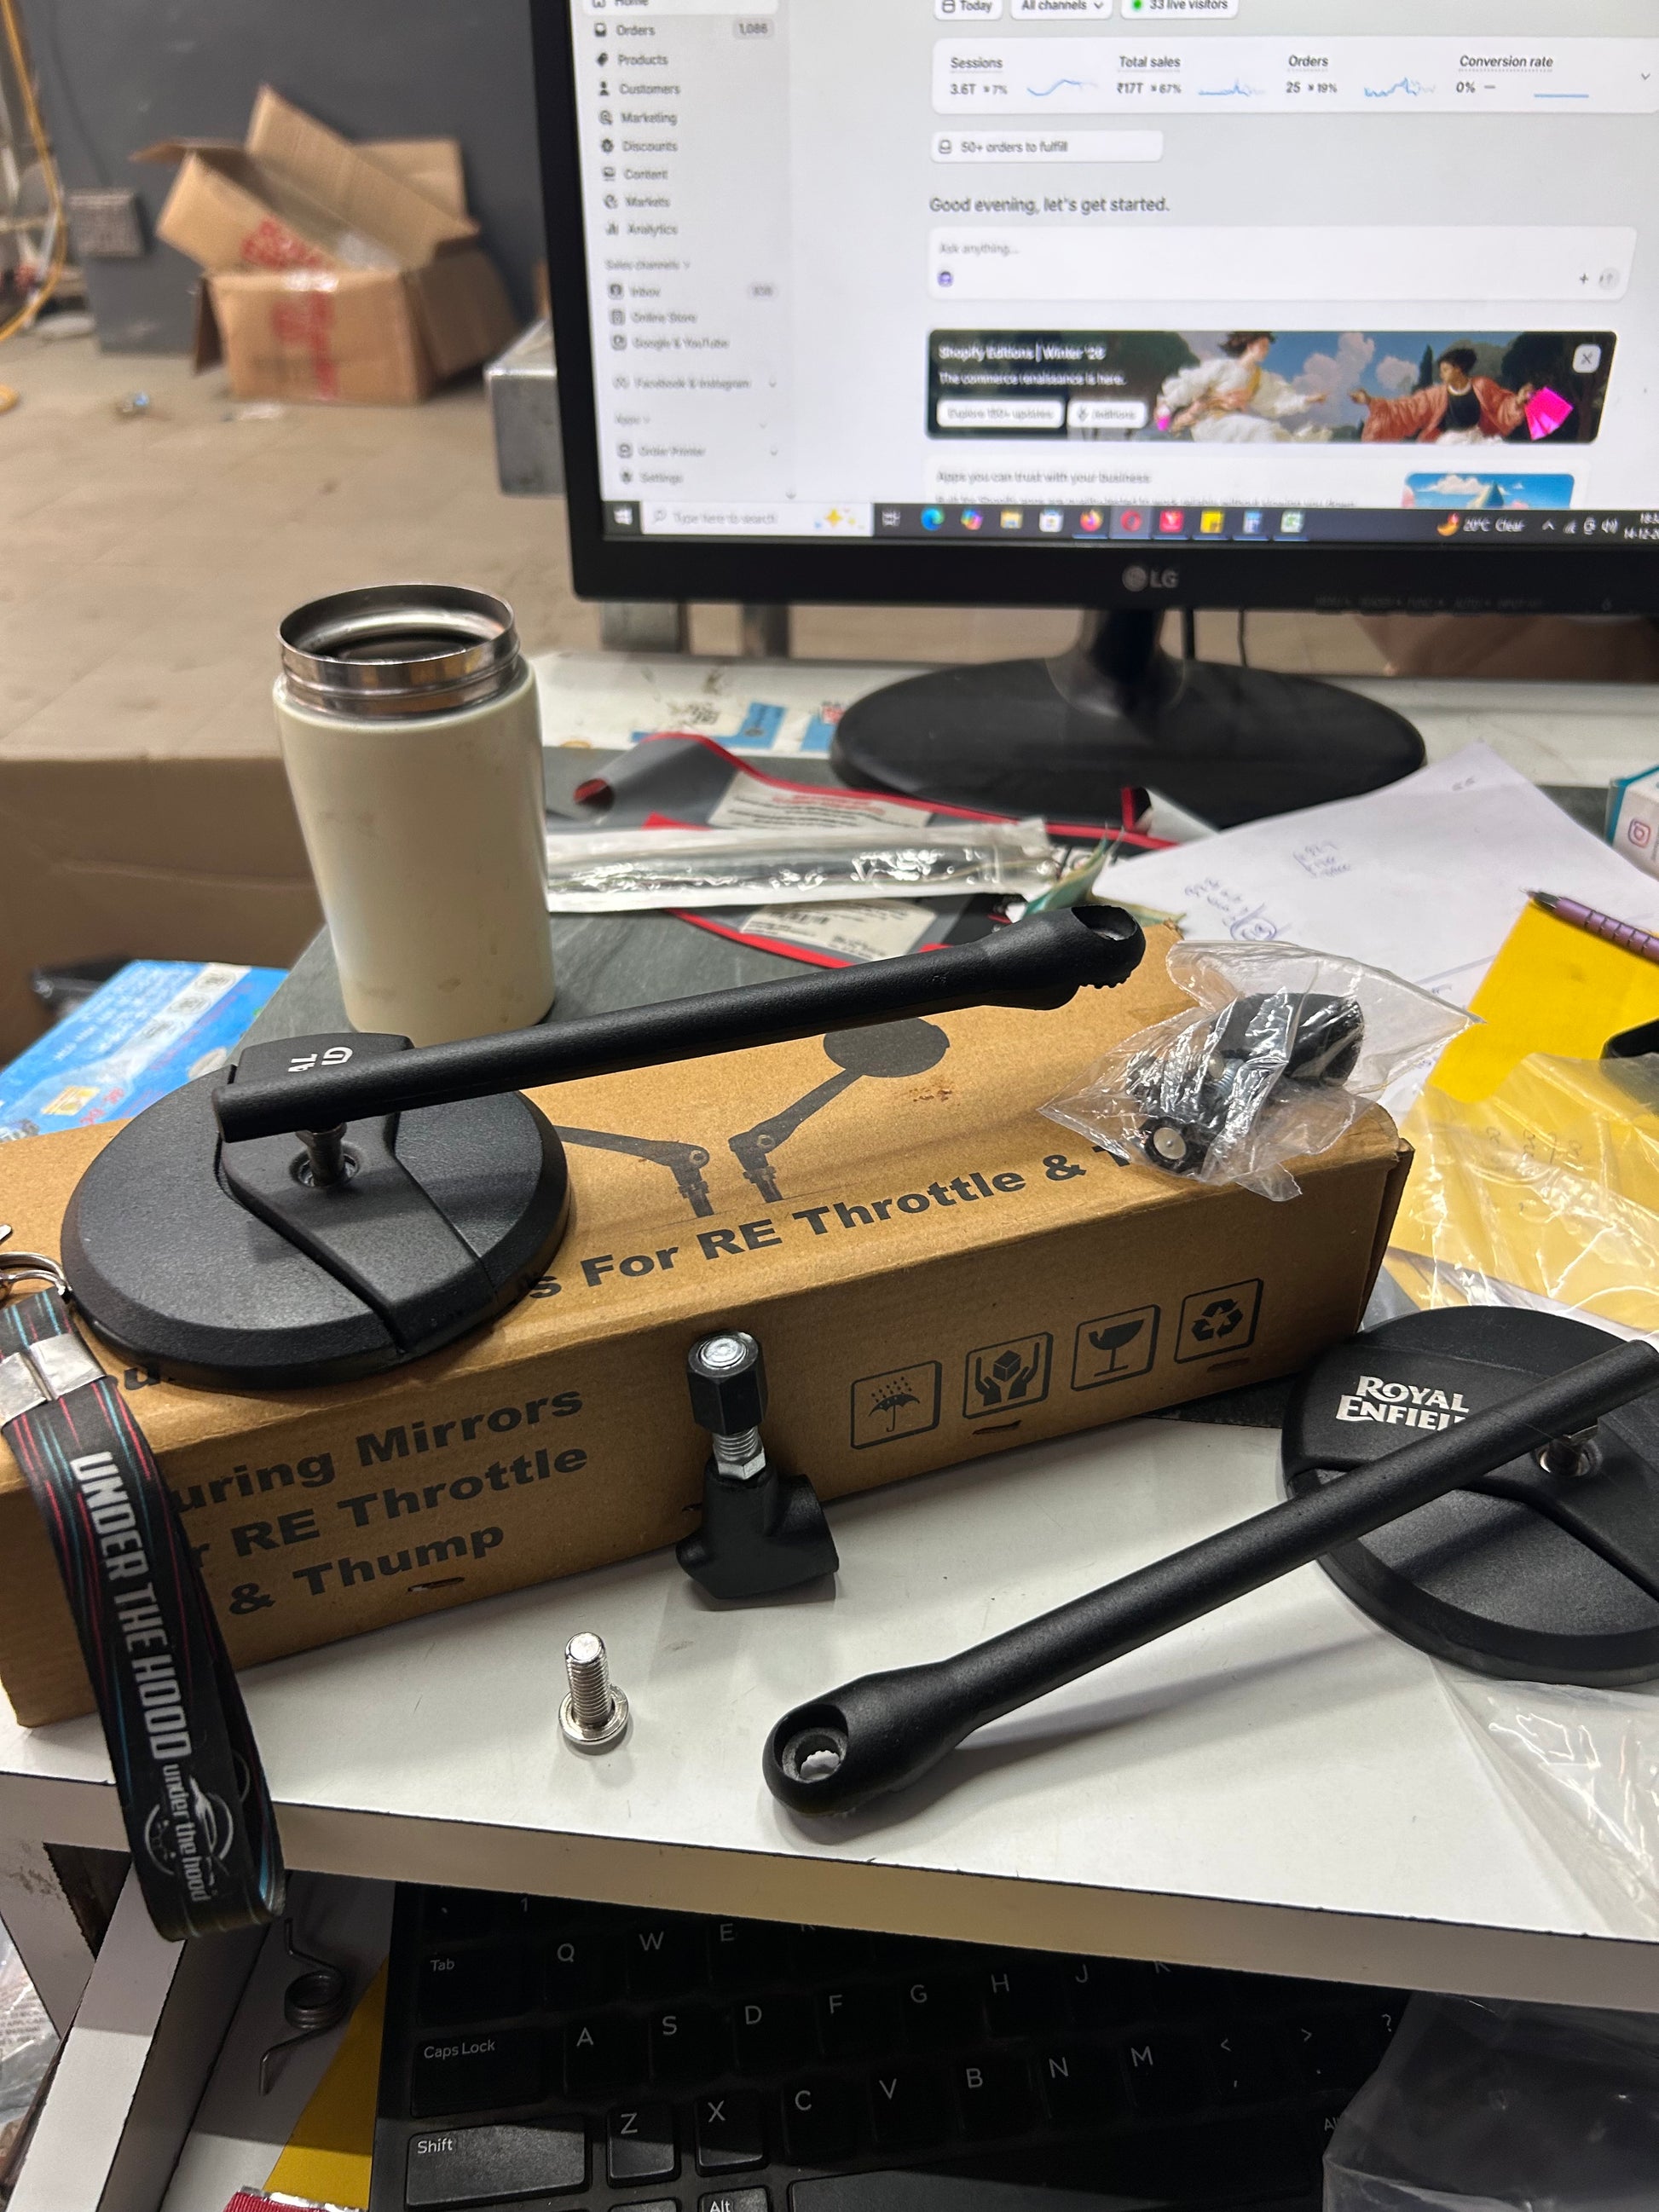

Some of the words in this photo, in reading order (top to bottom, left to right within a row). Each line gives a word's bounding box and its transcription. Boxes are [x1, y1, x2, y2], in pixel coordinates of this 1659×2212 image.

[960, 0, 992, 13] Today
[1021, 0, 1036, 10] All
[1041, 0, 1087, 11] channels
[1166, 0, 1187, 10] live
[1190, 0, 1228, 10] visitors
[616, 25, 656, 37] Orders
[618, 55, 668, 66] Products
[950, 56, 1003, 70] Sessions
[1119, 55, 1147, 68] Total
[1150, 55, 1181, 68] sales
[1288, 55, 1329, 67] Orders
[1460, 55, 1527, 69] Conversion
[1529, 56, 1554, 68] rate
[620, 84, 681, 95] Customers
[950, 83, 976, 95] 3.6T
[1286, 82, 1301, 94] 25
[1456, 81, 1477, 94] 0%
[621, 112, 678, 126] Marketing
[622, 140, 679, 153] Discounts
[960, 141, 983, 153] 50+
[986, 141, 1023, 153] orders
[1026, 141, 1037, 153] to
[1039, 140, 1068, 153] fulfill
[623, 169, 668, 181] Content
[625, 196, 671, 208] Markets
[929, 197, 971, 212] Good
[974, 197, 1040, 215] evening,
[1043, 197, 1078, 212] let's
[1081, 198, 1107, 215] get
[1110, 197, 1171, 212] started.
[627, 223, 679, 238] Analytics
[939, 242, 960, 255] Ask
[938, 343, 984, 361] Shopify
[1043, 344, 1084, 360] Winter
[939, 370, 960, 384] The
[961, 372, 1020, 385] commerce
[1043, 471, 1067, 483] with
[1071, 472, 1098, 486] your
[1149, 568, 1179, 589] LG
[580, 1245, 679, 1287] For
[696, 1220, 783, 1261] RE
[792, 1170, 1027, 1236] Throttle
[1043, 1153, 1087, 1181] &
[1356, 1374, 1470, 1413] ROYAL
[170, 1452, 338, 1513] uring
[355, 1389, 584, 1467] Mirrors
[229, 1508, 322, 1557] RE
[337, 1447, 589, 1528] Throttle
[69, 1451, 141, 1582] UNDER
[228, 1582, 277, 1615] &
[292, 1523, 506, 1597] Thump
[113, 1585, 170, 1657] THE
[130, 1652, 194, 1762] HOOD
[163, 1763, 190, 1820] under
[175, 1822, 198, 1855] the
[182, 1856, 212, 1903] hood
[639, 1932, 665, 1951] W
[719, 1923, 736, 1943] E
[556, 1943, 576, 1963] Q
[430, 1958, 456, 1972] Tab
[1075, 1964, 1090, 1984] J
[990, 1973, 1010, 1994] H
[910, 1984, 928, 2004] G
[828, 1994, 843, 2015] F
[662, 2015, 679, 2036] S
[744, 2005, 764, 2026] D
[575, 2027, 595, 2047] A
[424, 2045, 460, 2061] Caps
[460, 2038, 496, 2057] Lock
[1130, 2046, 1154, 2068] M
[966, 2068, 984, 2089] B
[1049, 2057, 1070, 2080] N
[878, 2077, 899, 2100] V
[706, 2099, 726, 2123] X
[794, 2090, 813, 2112] C
[619, 2112, 639, 2135] Z
[416, 2138, 454, 2155] Shift
[709, 2199, 731, 2212] Alt
